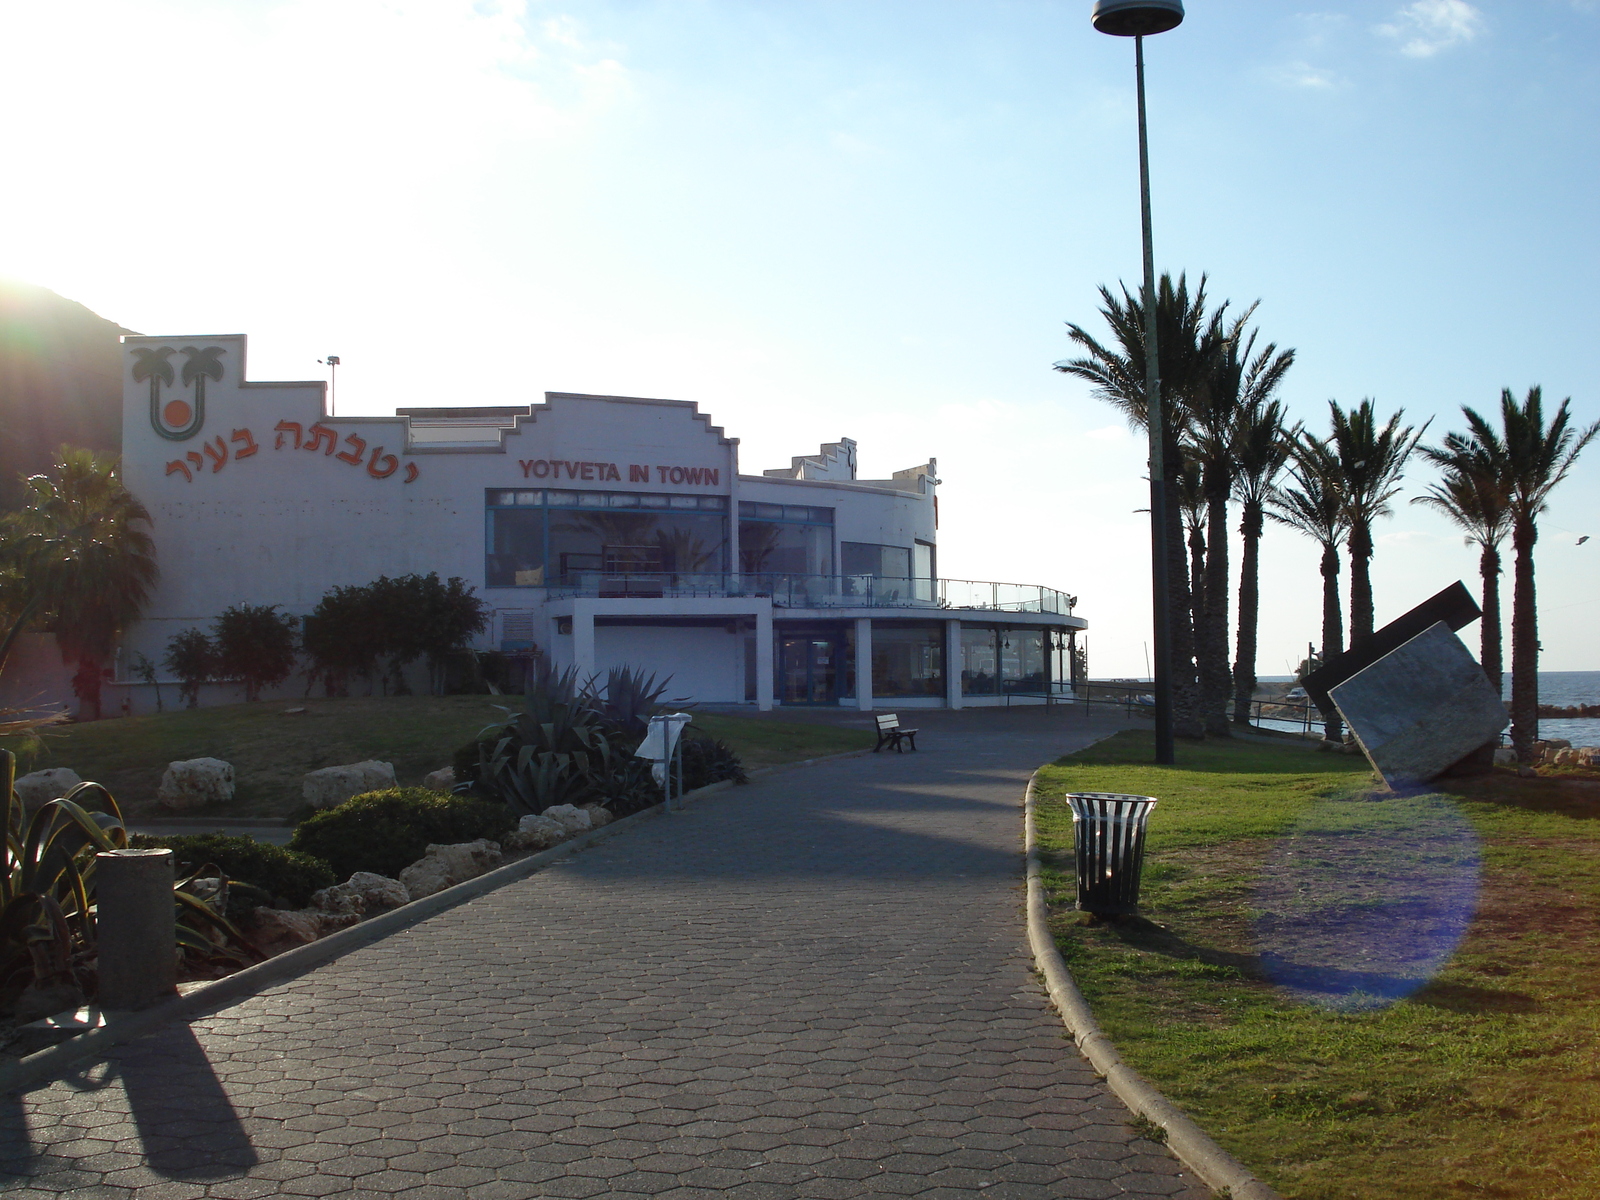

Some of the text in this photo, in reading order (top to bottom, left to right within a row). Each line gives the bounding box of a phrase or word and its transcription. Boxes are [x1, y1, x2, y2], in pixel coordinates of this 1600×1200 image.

[165, 419, 419, 484] יטבתה בעיר
[519, 459, 719, 486] YOTVETA IN TOWN
